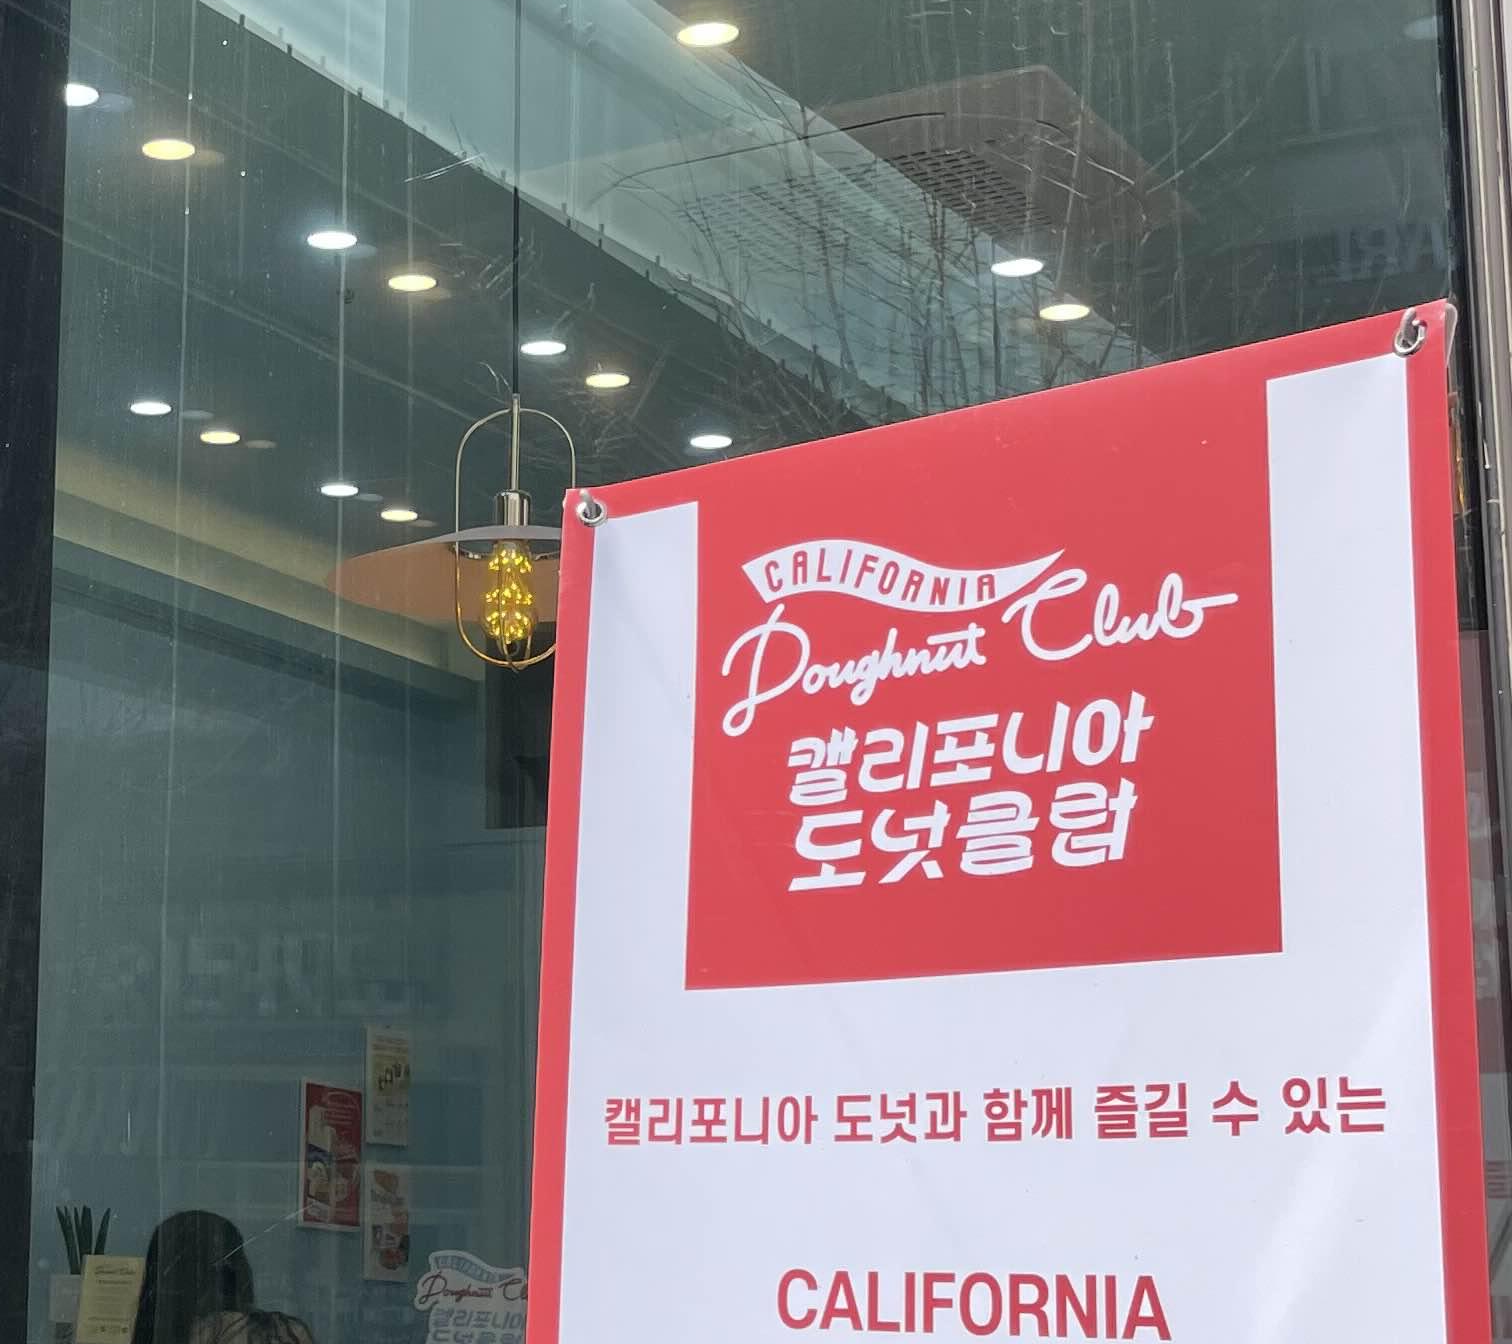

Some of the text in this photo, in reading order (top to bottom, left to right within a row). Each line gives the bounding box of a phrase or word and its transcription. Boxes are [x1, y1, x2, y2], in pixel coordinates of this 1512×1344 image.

[765, 547, 997, 608] CALIFORNIA
[720, 567, 1238, 738] Doughnut Club
[786, 690, 1155, 807] 캘리포니아
[786, 777, 1138, 893] 도넛클럽
[603, 1075, 1387, 1148] 캘리포니아 도넛과 함께 즐길 수 있는
[775, 1268, 1173, 1342] CALIFORNIA
